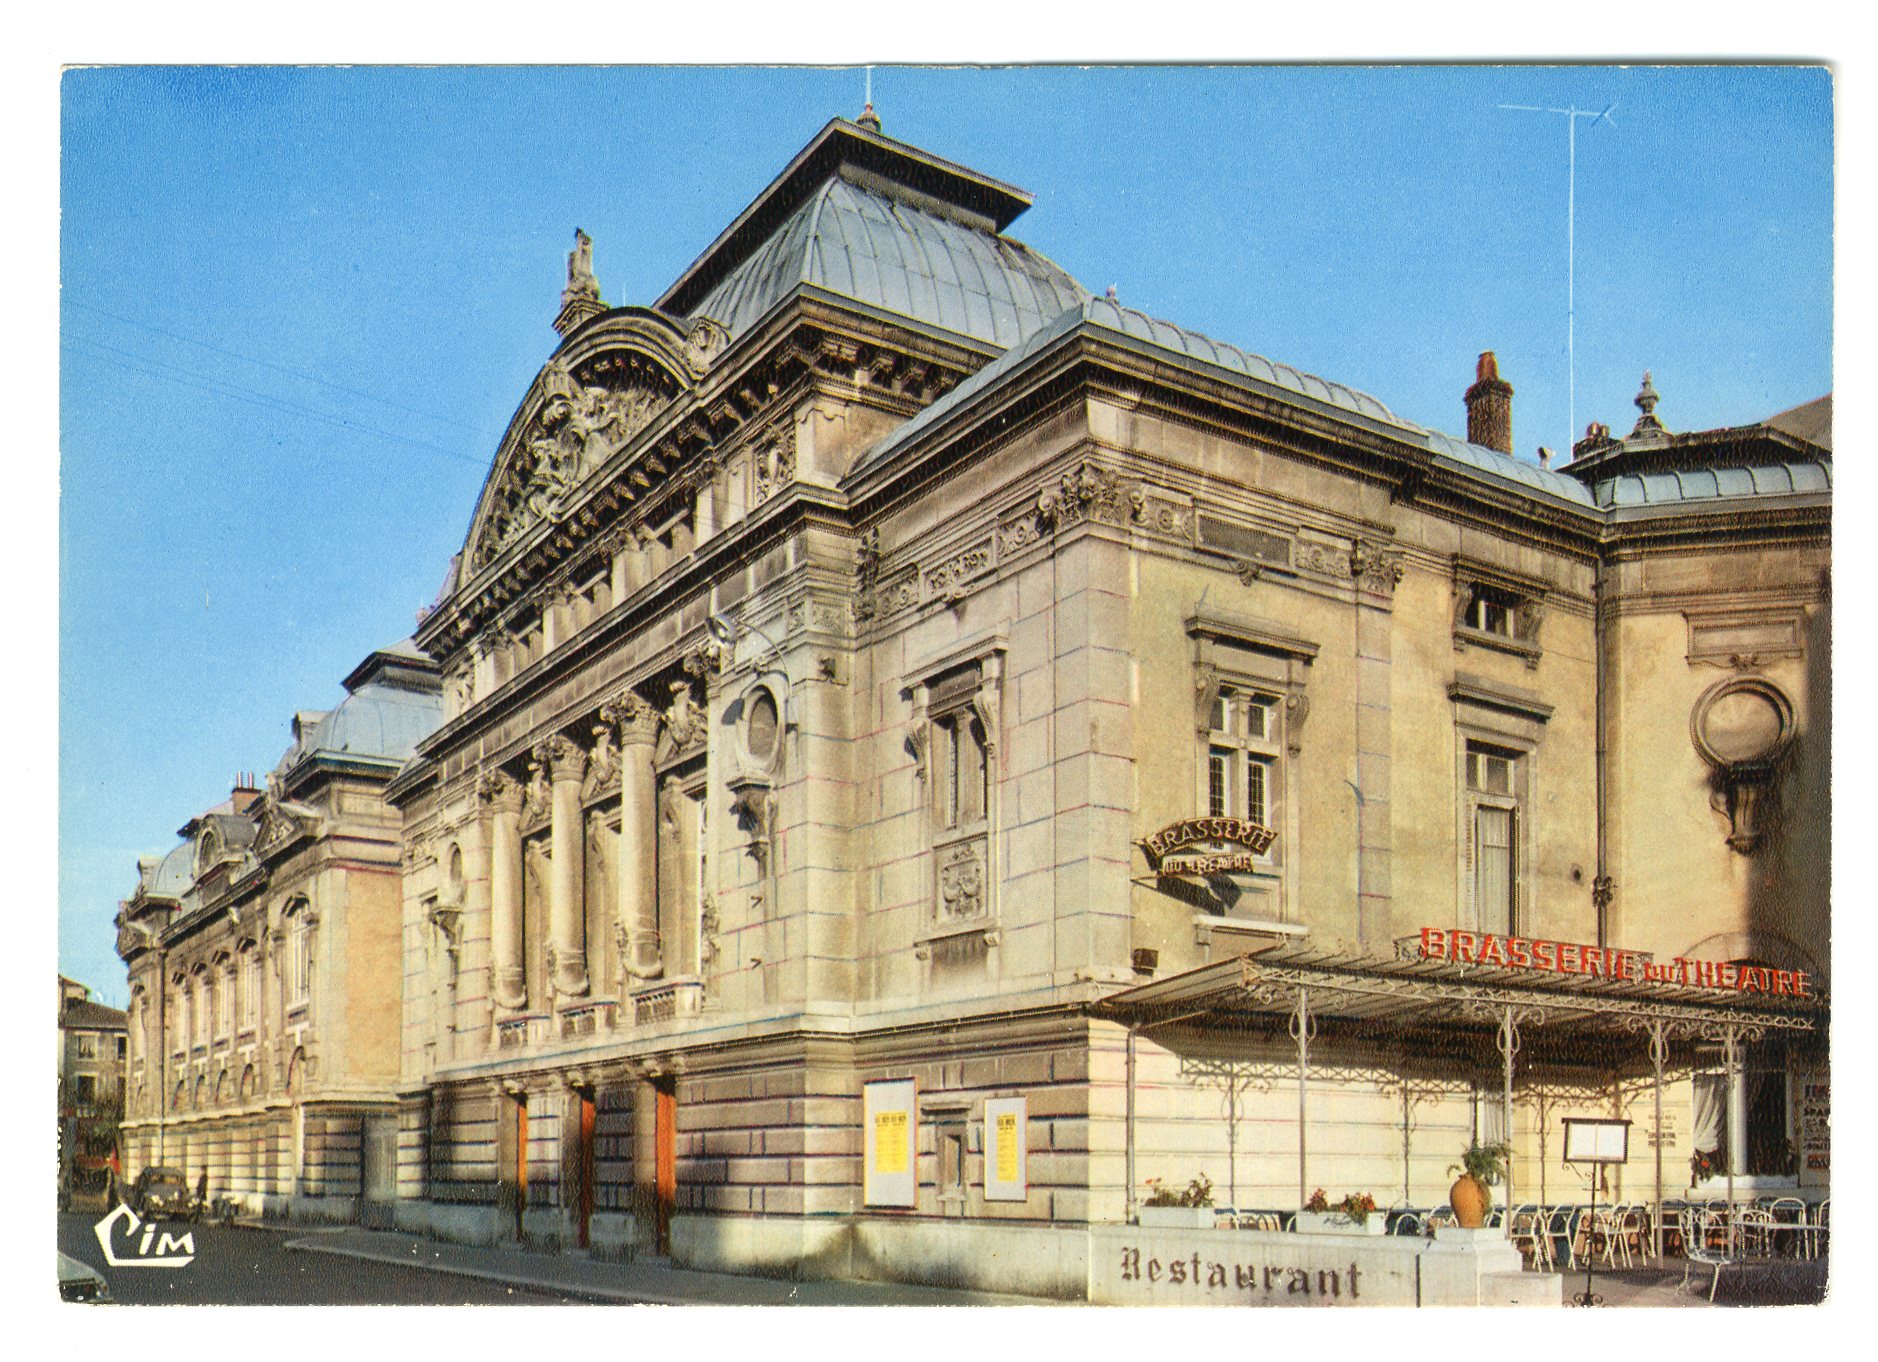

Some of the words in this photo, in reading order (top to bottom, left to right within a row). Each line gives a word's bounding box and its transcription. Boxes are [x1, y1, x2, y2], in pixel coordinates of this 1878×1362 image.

[1148, 820, 1275, 857] BRASSERIE
[1420, 927, 1637, 981] BRASSERIE
[1673, 956, 1812, 998] THEATRE
[1121, 1246, 1361, 1299] Restaurant
